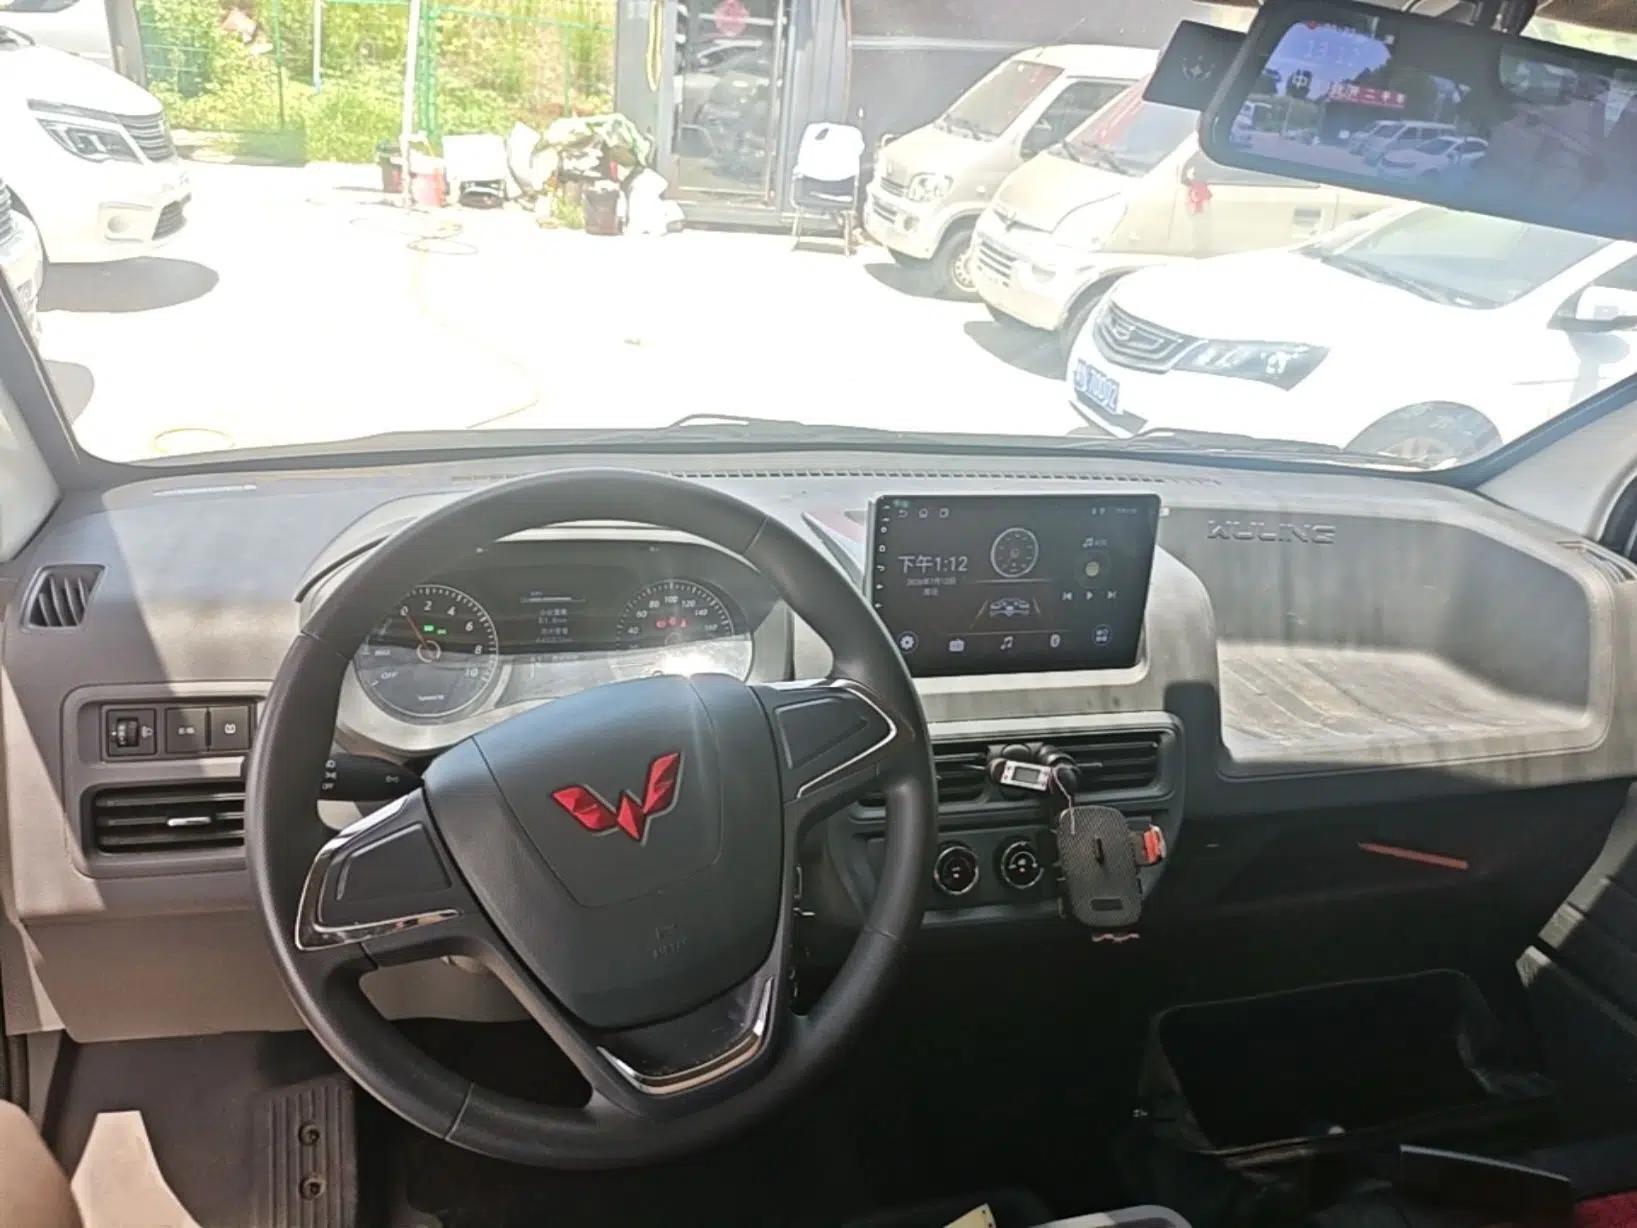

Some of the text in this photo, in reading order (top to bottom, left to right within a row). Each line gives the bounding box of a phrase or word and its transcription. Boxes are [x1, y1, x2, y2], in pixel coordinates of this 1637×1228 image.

[1206, 519, 1337, 545] WULING
[898, 554, 969, 574] 下午1:12
[648, 600, 660, 608] 80
[681, 600, 696, 608] 120
[636, 610, 648, 618] 60
